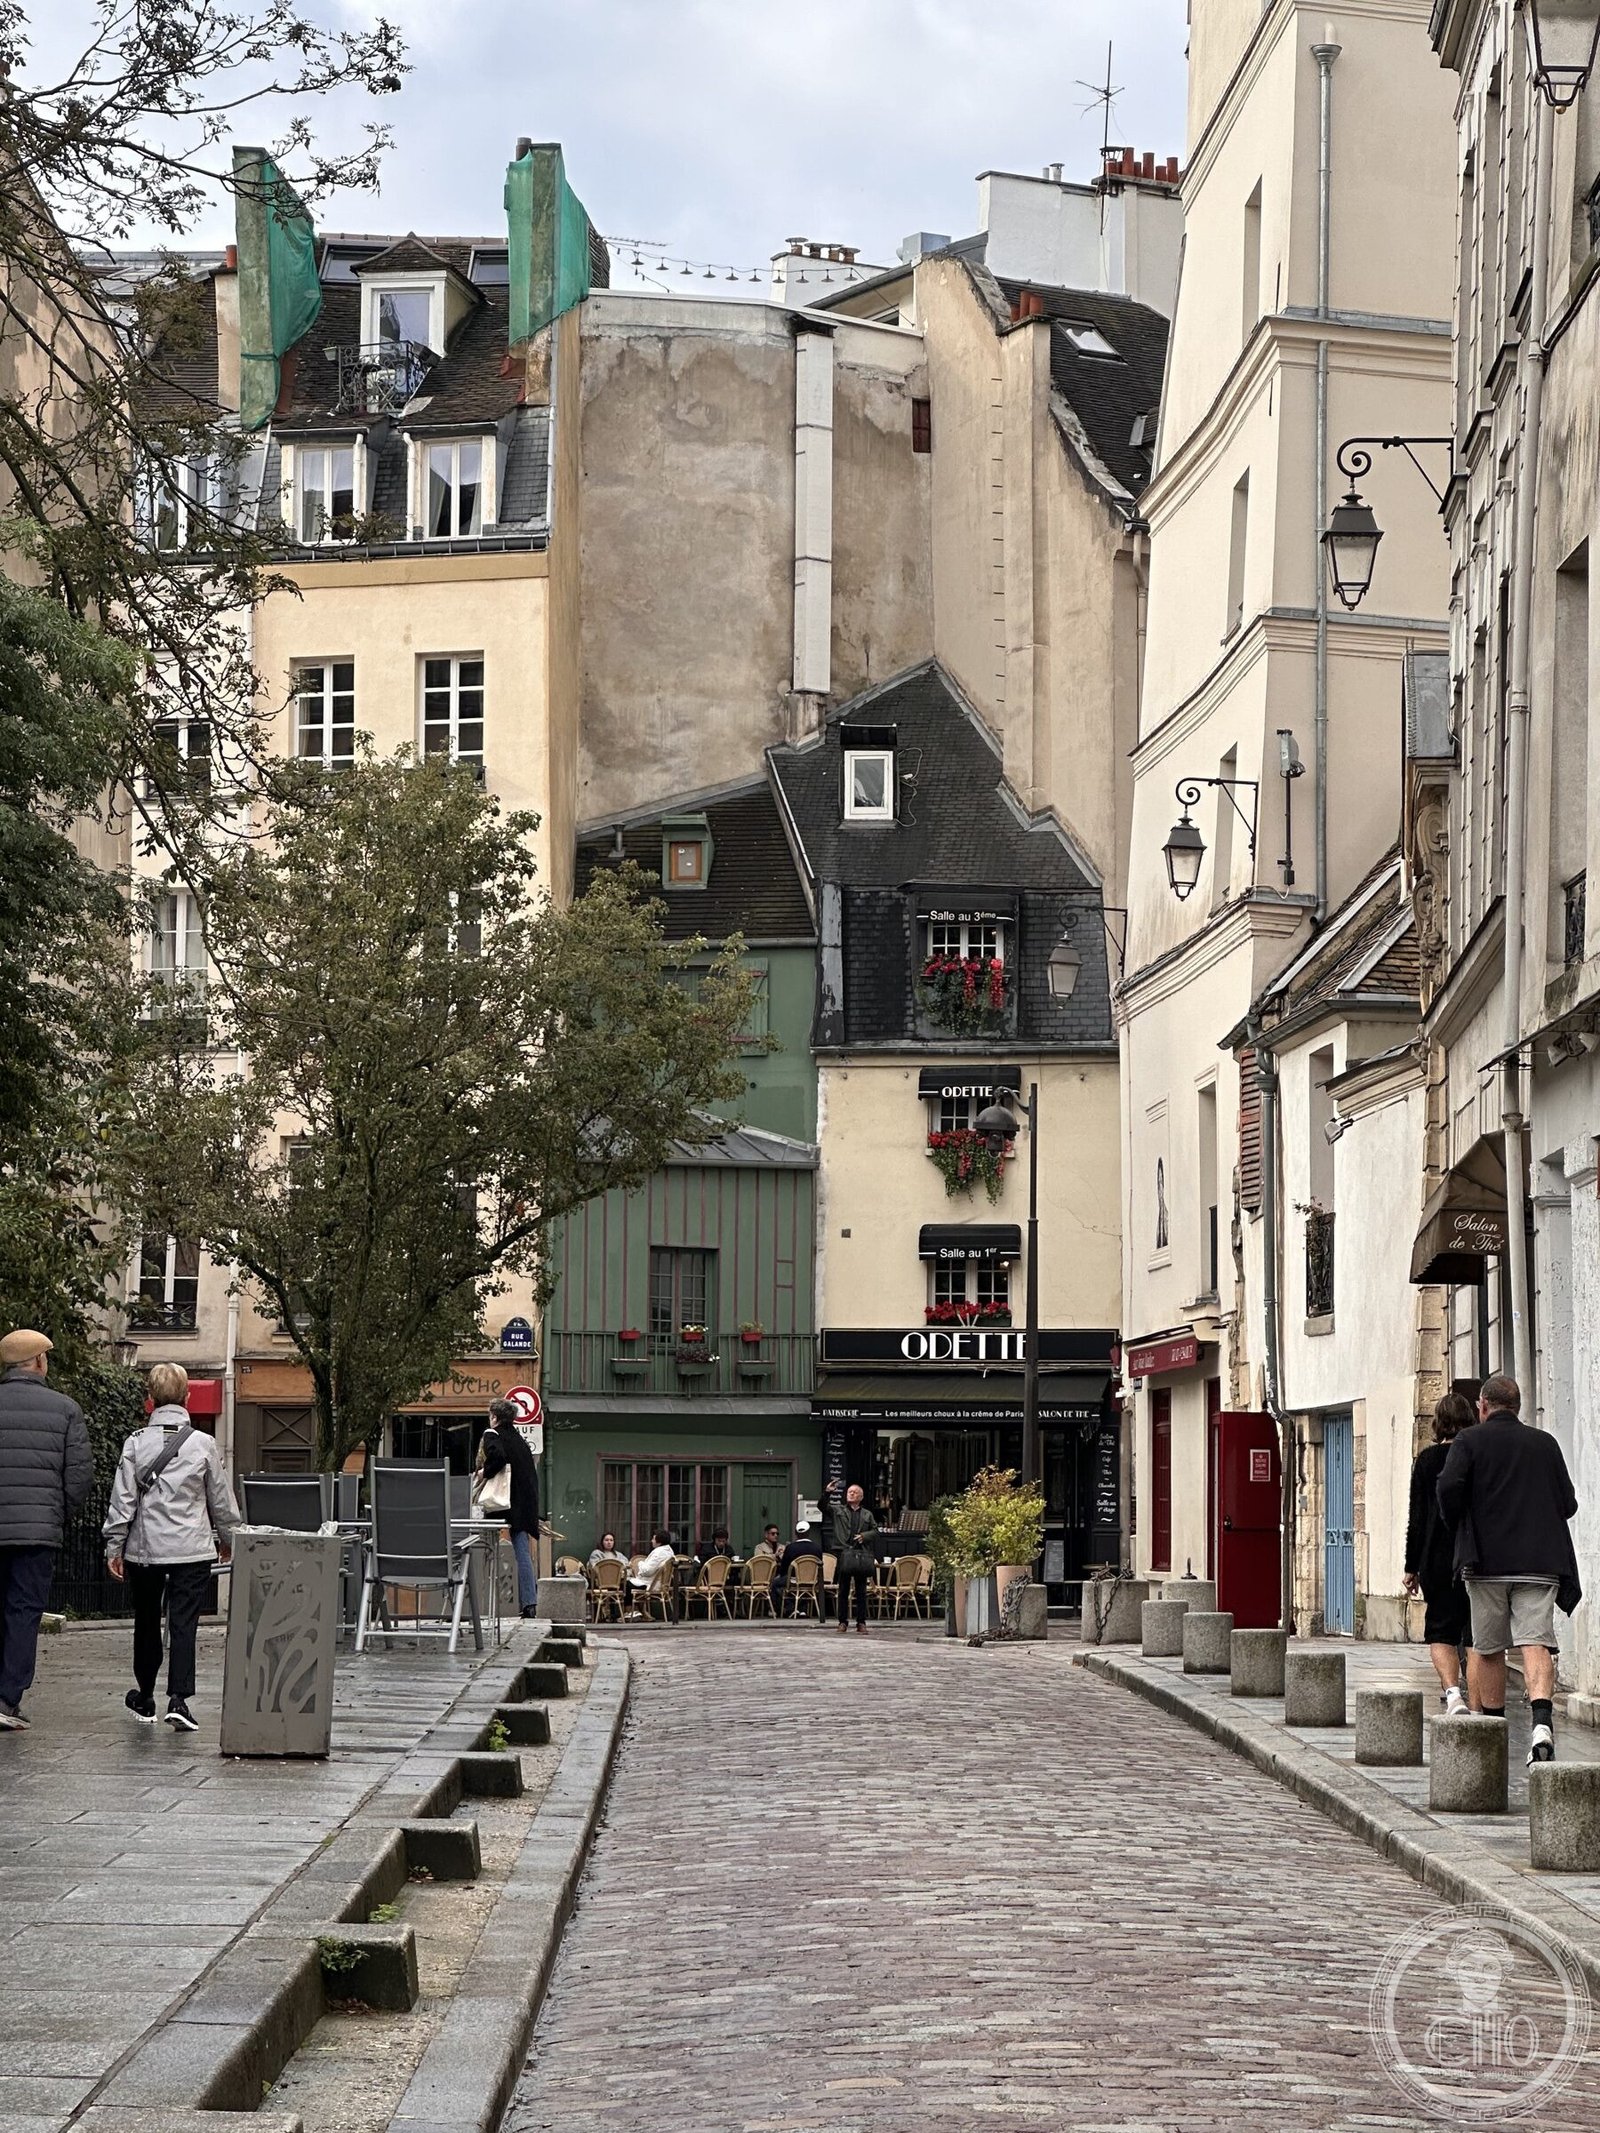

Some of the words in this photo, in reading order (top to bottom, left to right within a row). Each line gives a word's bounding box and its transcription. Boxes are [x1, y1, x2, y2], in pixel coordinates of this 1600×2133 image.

[930, 910, 955, 921] Salle
[958, 912, 971, 921] au
[941, 1085, 993, 1098] ODETTE
[1453, 1213, 1499, 1233] Salon
[1448, 1235, 1466, 1249] de
[1471, 1232, 1505, 1251] Thé
[940, 1248, 966, 1258] Salle
[968, 1249, 982, 1258] au
[984, 1247, 998, 1258] 1er
[900, 1331, 1027, 1360] ODETTE
[885, 1410, 899, 1418] Les
[899, 1410, 933, 1418] meilleurs
[933, 1410, 956, 1418] choux
[956, 1410, 962, 1418] à
[962, 1410, 970, 1418] la
[994, 1410, 1004, 1418] de
[1005, 1410, 1025, 1418] Paris
[1038, 1409, 1063, 1419] SALON
[1063, 1410, 1074, 1418] DE
